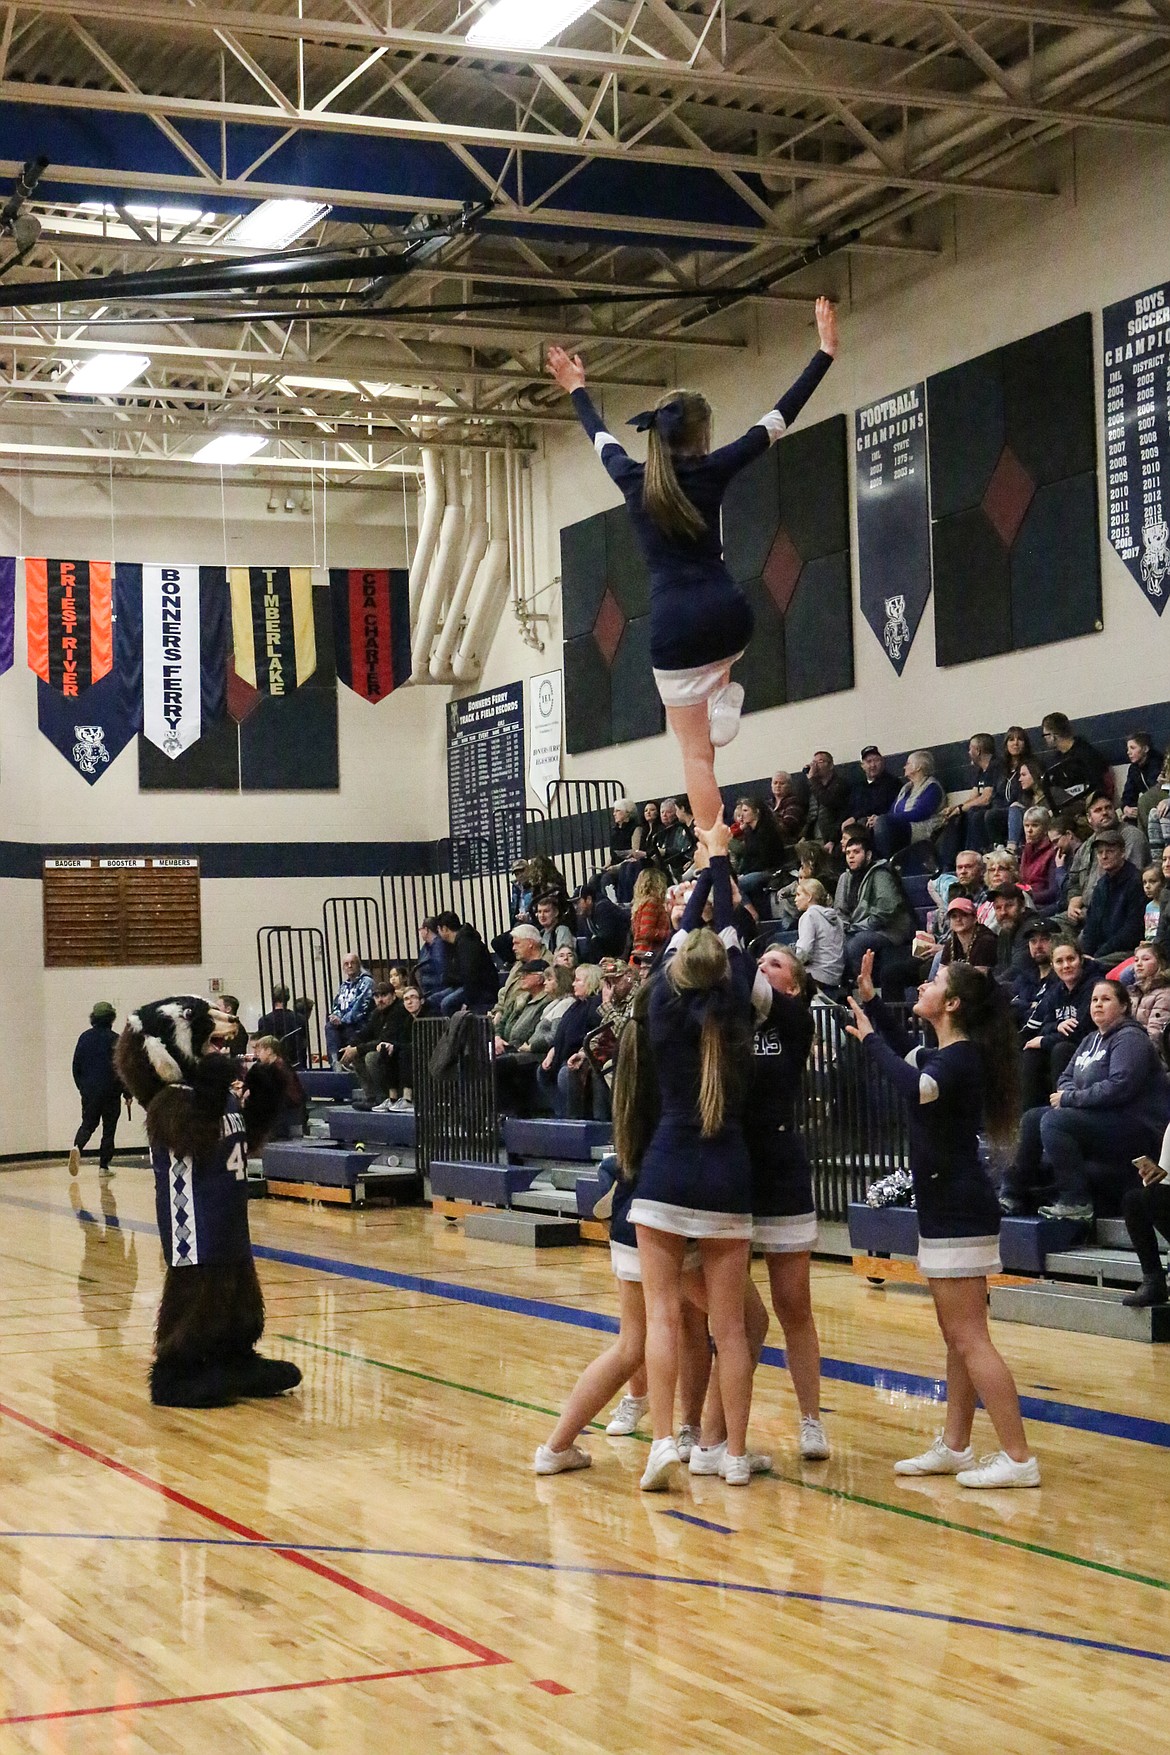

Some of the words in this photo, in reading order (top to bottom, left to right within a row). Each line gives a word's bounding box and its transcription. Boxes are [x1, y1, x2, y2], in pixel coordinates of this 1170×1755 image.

[1135, 290, 1165, 315] BOYS
[1128, 306, 1170, 336] SOCCER
[1133, 354, 1165, 375] DISTRICT
[1110, 370, 1122, 383] IML
[1137, 372, 1154, 387] 2003
[1108, 384, 1124, 399] 2003
[1137, 387, 1154, 402] 2005
[860, 390, 919, 430] FOOTBALL
[1107, 398, 1124, 412] 2004
[1137, 401, 1155, 416] 2006
[1108, 412, 1124, 427] 2005
[1138, 416, 1155, 431] 2007
[857, 413, 924, 451] CHAMPIONS
[1108, 427, 1125, 441] 2006
[1139, 431, 1157, 446] 2008
[1109, 441, 1126, 456] 2007
[1141, 447, 1159, 460] 2009
[1109, 456, 1127, 470] 2008
[1142, 462, 1160, 476] 2010
[1110, 471, 1128, 484] 2009
[1143, 476, 1160, 490] 2011
[1110, 486, 1128, 500] 2010
[1144, 490, 1162, 504] 2012
[1110, 500, 1128, 514] 2011
[1144, 504, 1162, 517] 2013
[1111, 513, 1130, 526] 2012
[1111, 526, 1130, 540] 2013
[1122, 546, 1140, 560] 2017
[60, 562, 77, 634] PRIEST
[362, 574, 376, 608] CDA
[162, 570, 181, 661] BONNERS
[262, 570, 285, 695] TIMBERLAKE
[364, 614, 380, 696] CHARTER
[62, 637, 78, 696] RIVER
[163, 666, 182, 730] FERRY
[460, 712, 474, 725] TRACK
[481, 708, 495, 720] FIELD
[496, 701, 518, 715] RECORDS
[226, 1141, 248, 1181] 4
